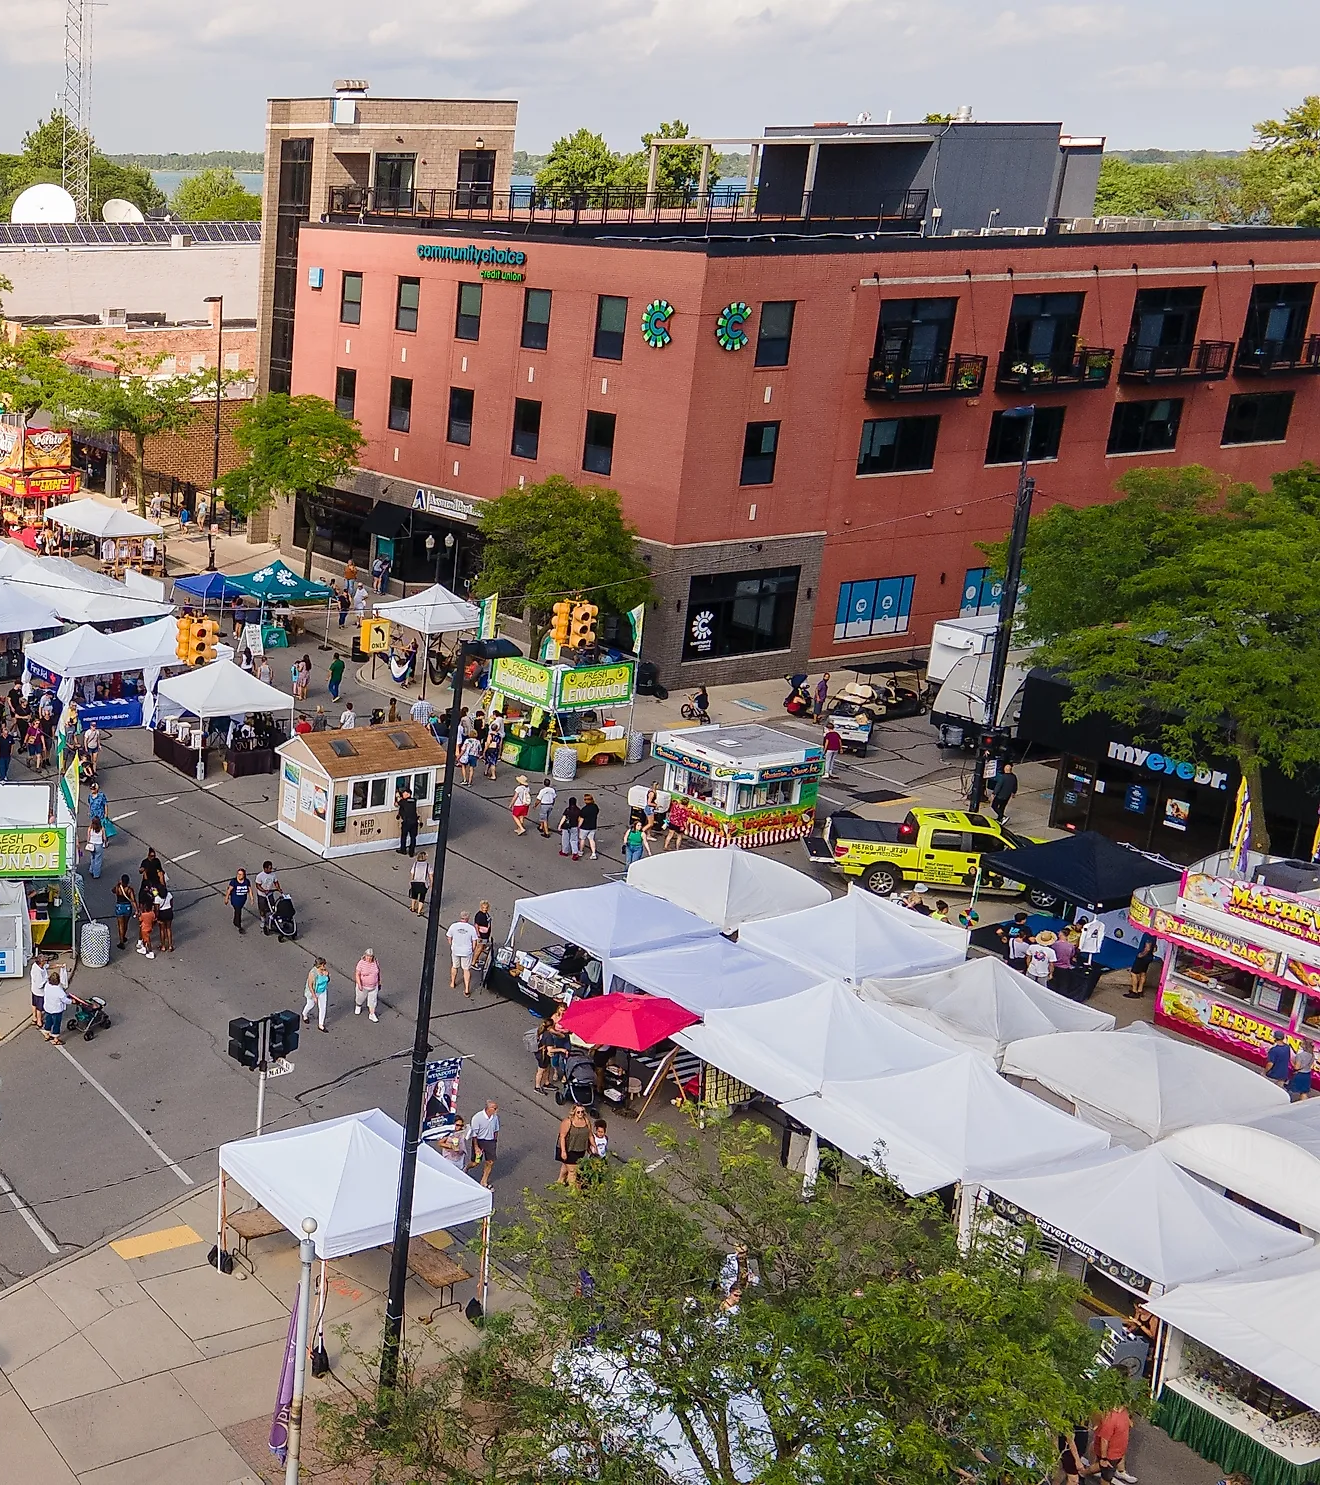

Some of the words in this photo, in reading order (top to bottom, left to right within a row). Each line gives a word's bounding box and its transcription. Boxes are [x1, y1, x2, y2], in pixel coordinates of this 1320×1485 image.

[480, 269, 500, 279] credit
[502, 272, 522, 281] union
[583, 670, 608, 681] FRESH
[576, 678, 615, 689] SQUEEZED
[561, 683, 629, 703] LEMONADE
[655, 746, 678, 761] Hawaiian
[682, 757, 699, 769] Shave
[700, 763, 710, 773] Ice
[762, 770, 787, 780] Hawaiian
[792, 767, 809, 776] Shave
[810, 764, 819, 773] Ice
[360, 819, 374, 828] NEED
[851, 843, 874, 851] METRO
[876, 846, 909, 854] JIU-JITSU
[1167, 918, 1229, 949] ELEPHANT
[1232, 943, 1266, 967] EARS
[1208, 1004, 1301, 1053] ELEPHN
[1233, 1034, 1261, 1047] FRESH
[1034, 1217, 1067, 1241] Carved
